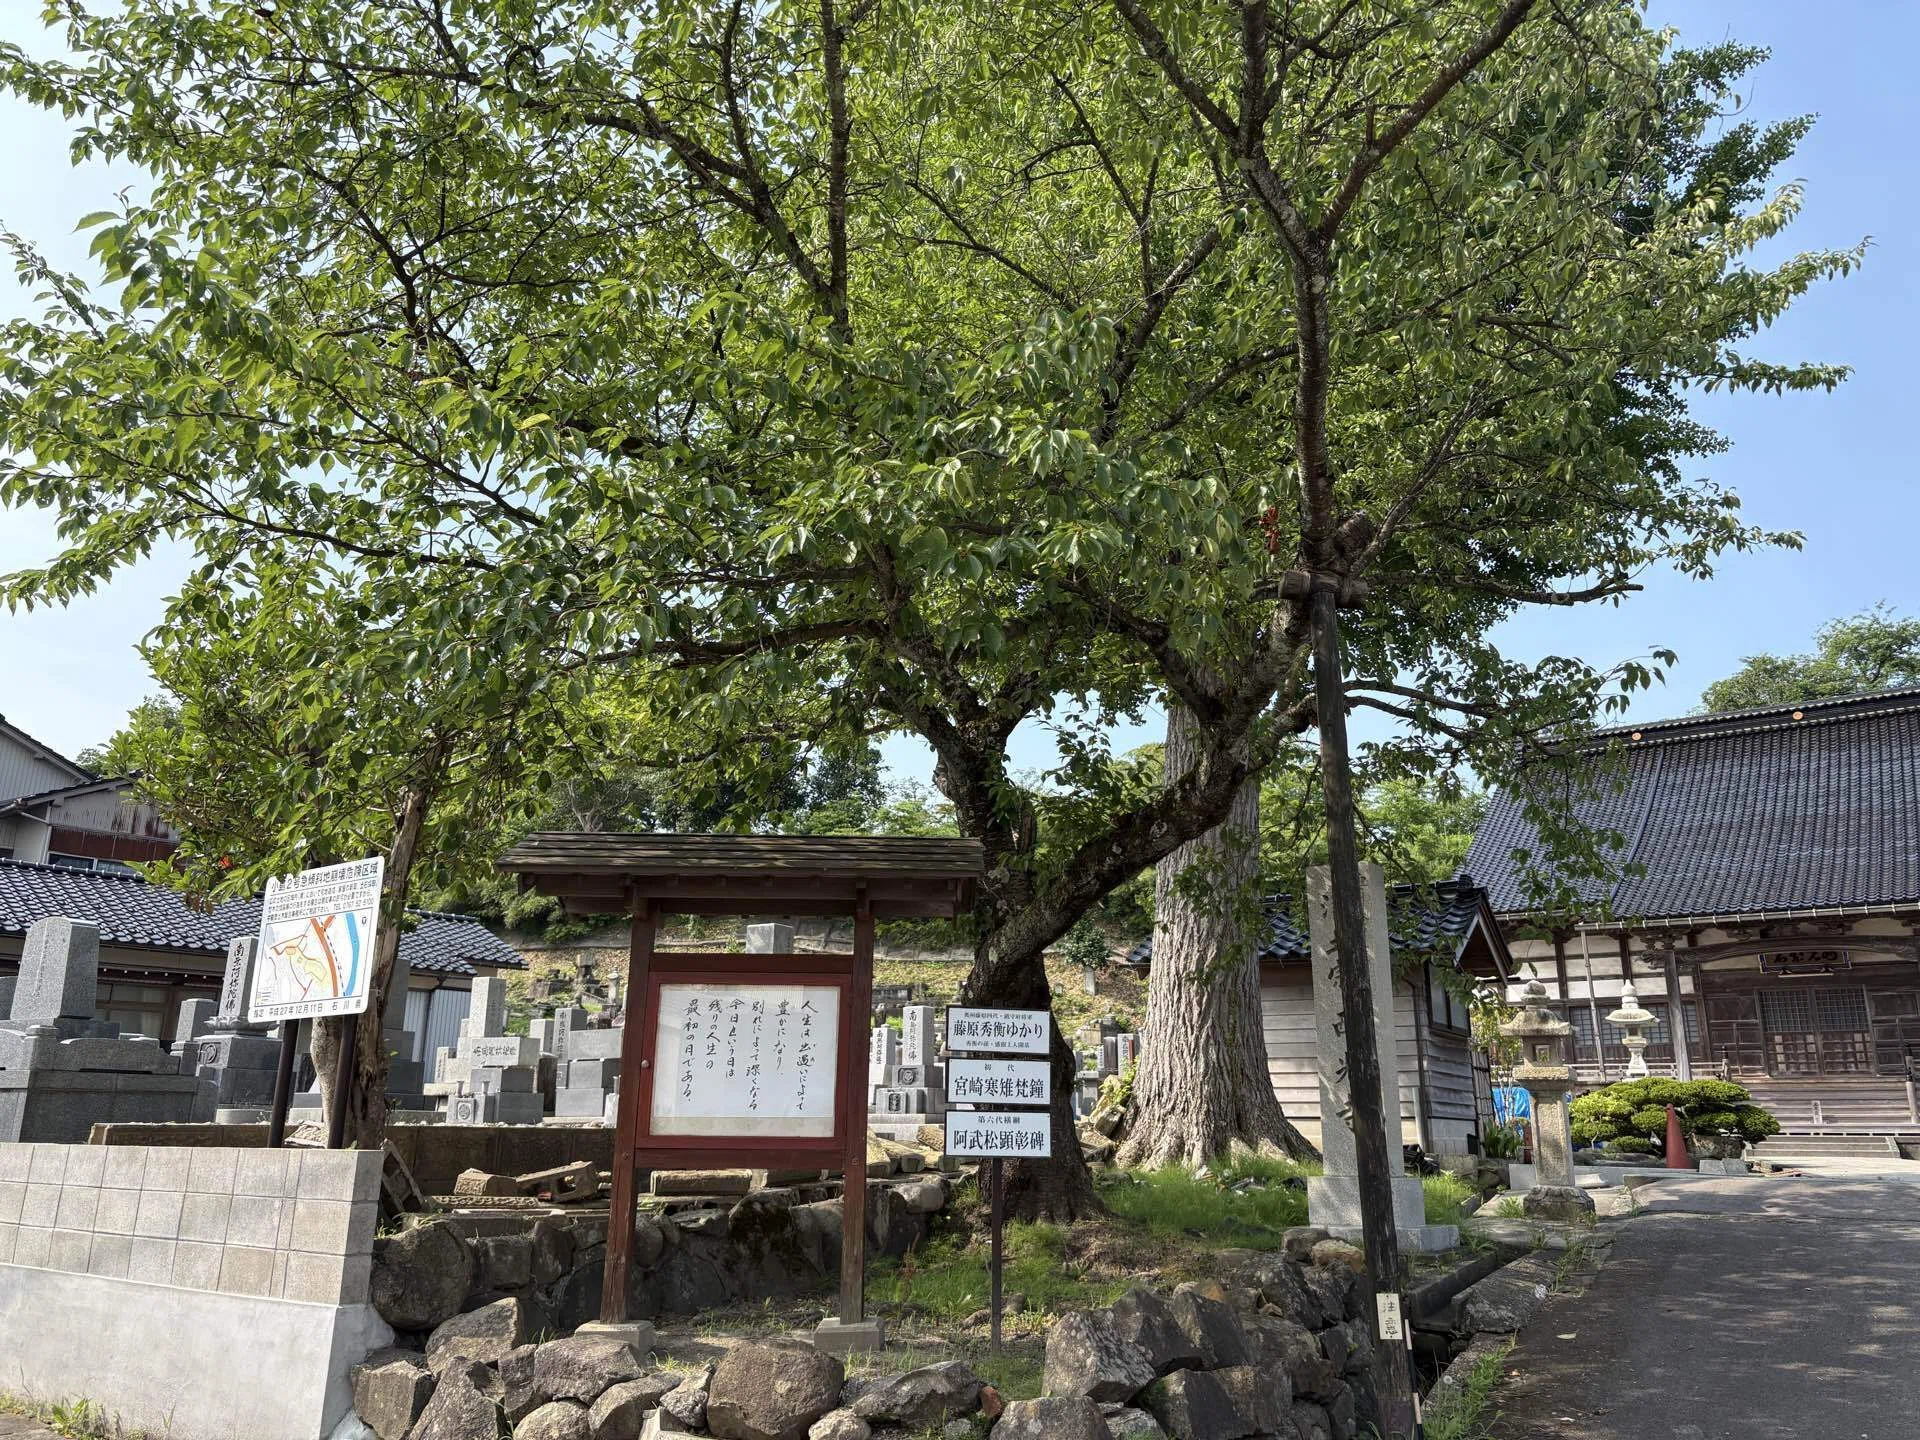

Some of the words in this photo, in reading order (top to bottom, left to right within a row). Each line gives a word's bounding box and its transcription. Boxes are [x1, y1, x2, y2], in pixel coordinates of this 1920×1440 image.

[269, 1004, 323, 1016] 平成27年12月11日
[705, 998, 722, 1070] 残りの人生の
[725, 998, 745, 1079] 今日という日は
[953, 1020, 1044, 1039] 藤原秀衡ゆかり
[954, 1075, 1044, 1099] 宮崎寒雉梵鐘
[978, 1115, 1021, 1124] 第六代横綱
[953, 1129, 1044, 1151] 阿武松顕彰碑
[1381, 1301, 1398, 1335] 注意
